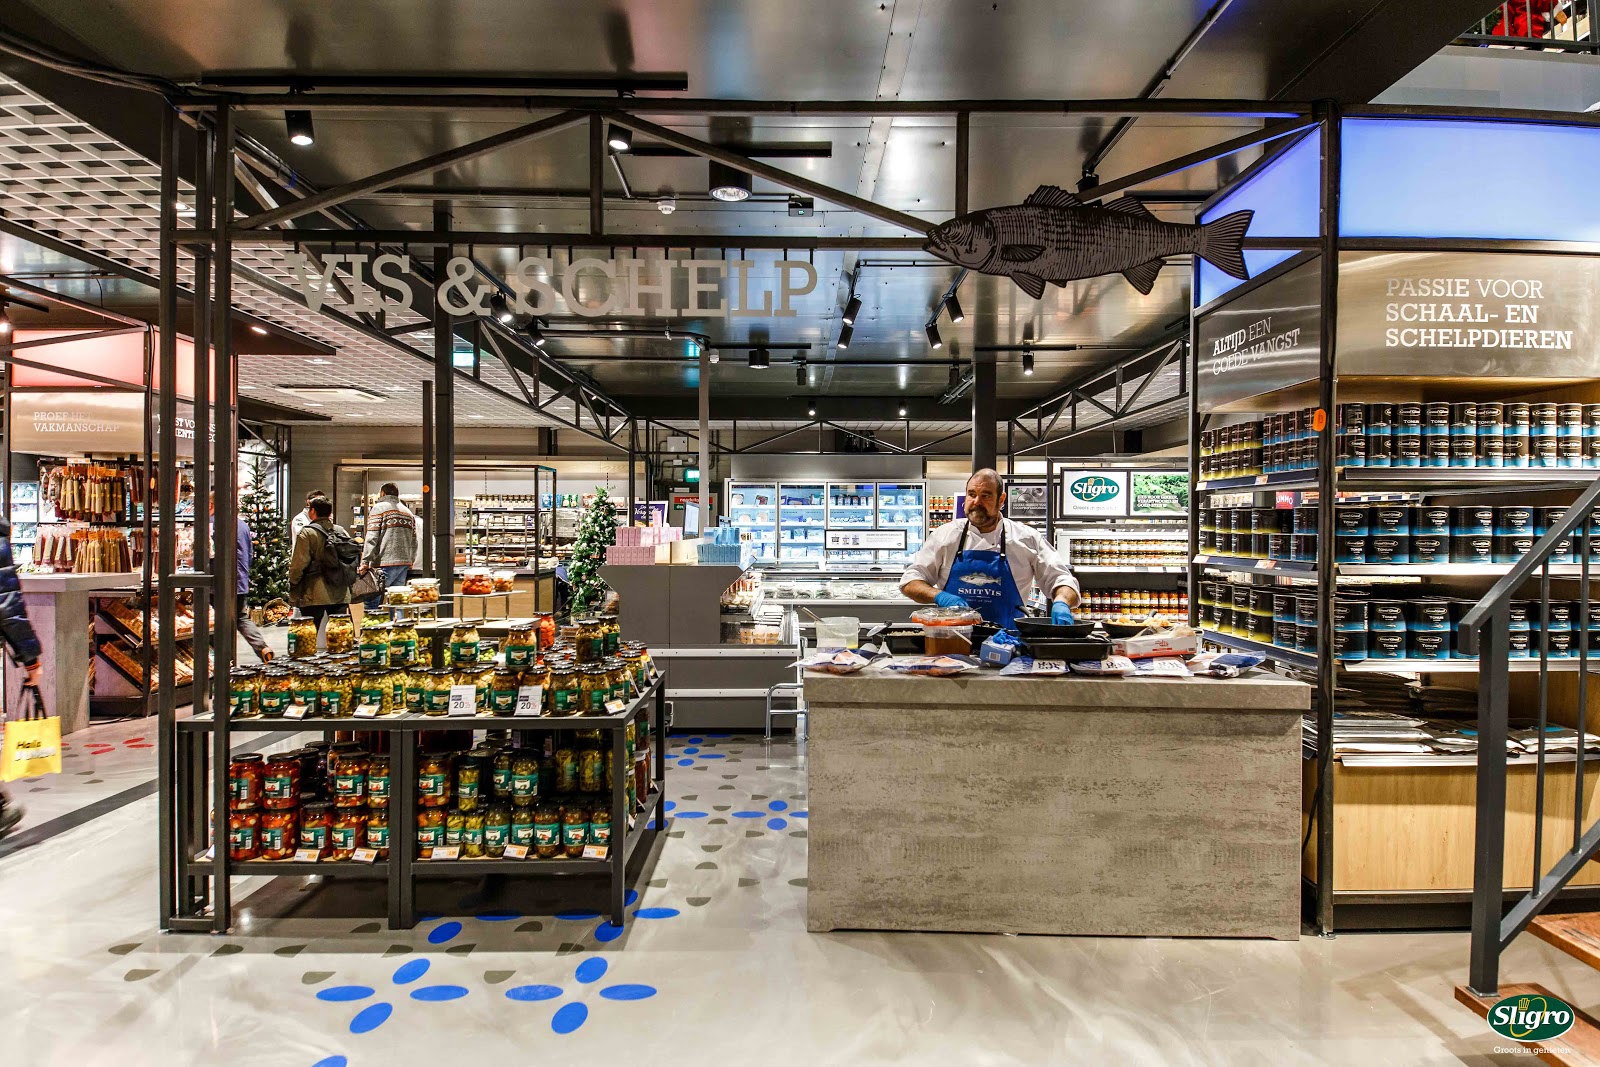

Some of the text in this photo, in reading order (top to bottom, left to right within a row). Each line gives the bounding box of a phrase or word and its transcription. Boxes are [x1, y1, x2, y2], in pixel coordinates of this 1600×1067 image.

[283, 252, 818, 317] VIS & SCHELP
[1386, 278, 1544, 299] PASSIE VOOR
[1386, 303, 1539, 324] SCHAAL- EN
[1212, 316, 1272, 356] ALTIJD EEN
[1386, 328, 1573, 350] SCHELPDIEREN
[1212, 327, 1300, 375] GOEDE VANGST
[33, 411, 69, 421] PROEF
[33, 422, 120, 432] VAKMANSCHAP
[1072, 482, 1119, 497] Sligro
